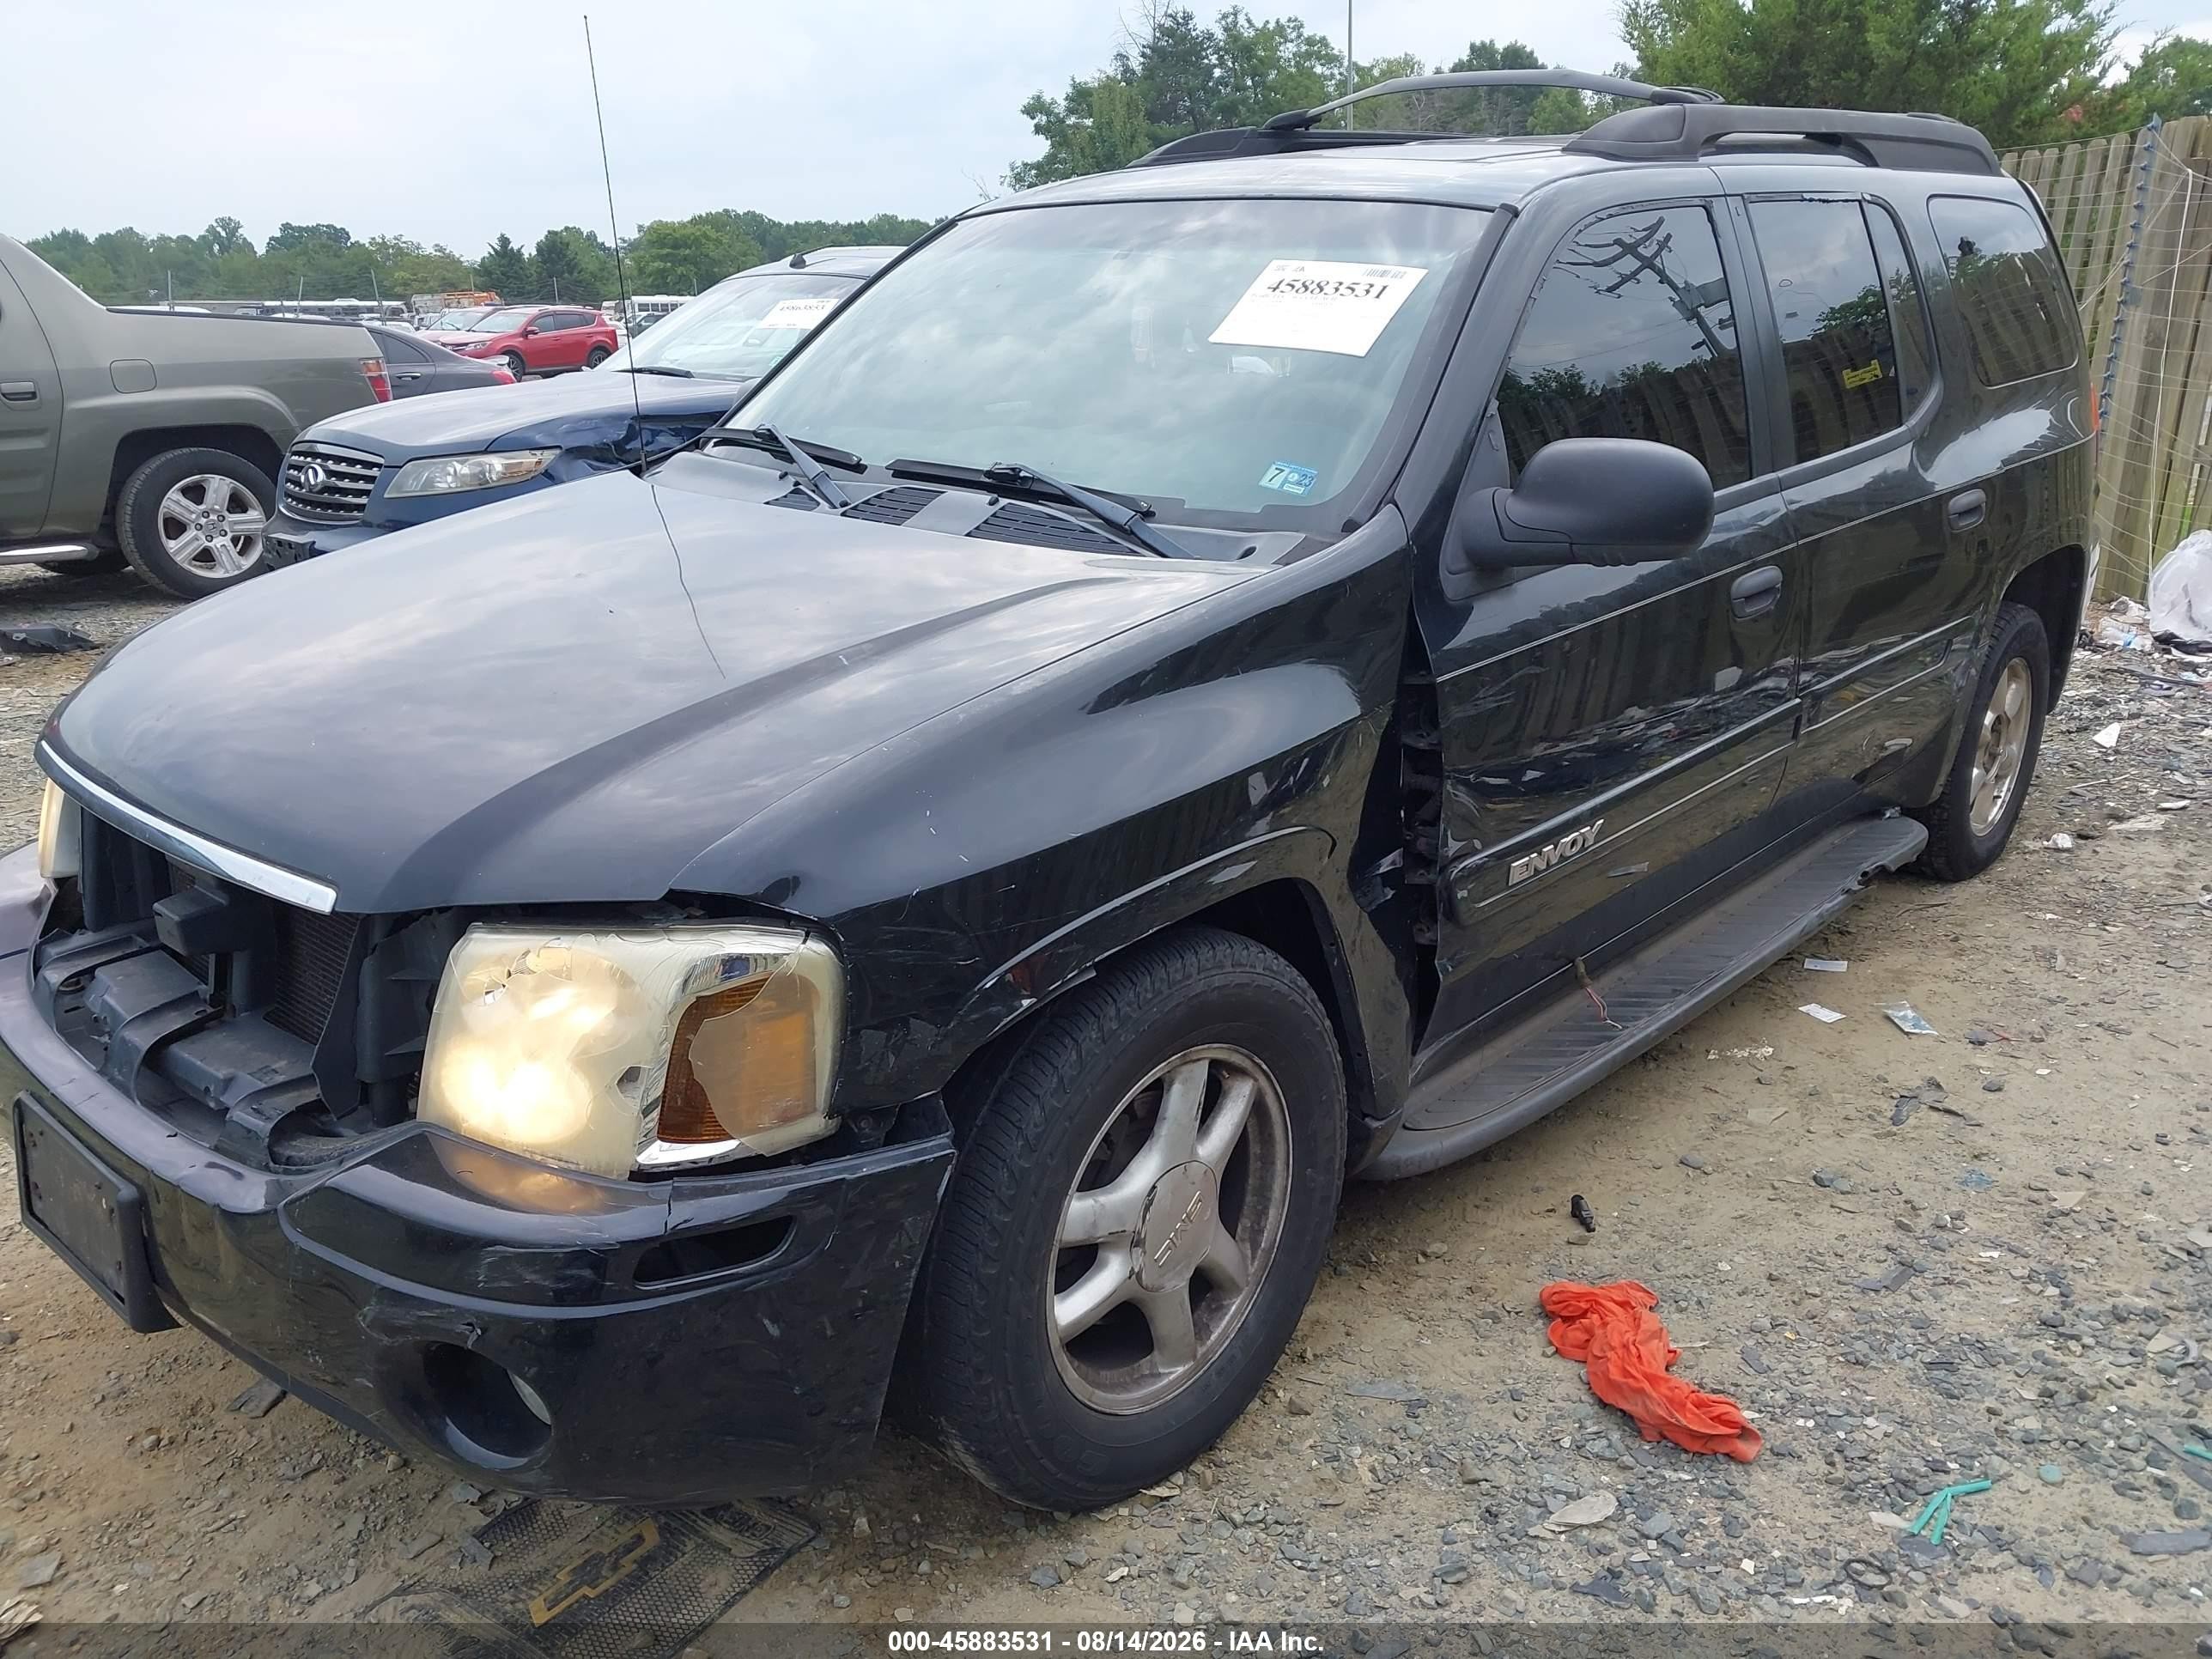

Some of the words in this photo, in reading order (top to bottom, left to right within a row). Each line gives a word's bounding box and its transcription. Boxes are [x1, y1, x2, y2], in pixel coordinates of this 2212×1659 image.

[1267, 277, 1389, 300] 45883531
[1268, 467, 1285, 483] 7
[1508, 818, 1605, 886] ENVOY
[1153, 1189, 1203, 1267] GMC
